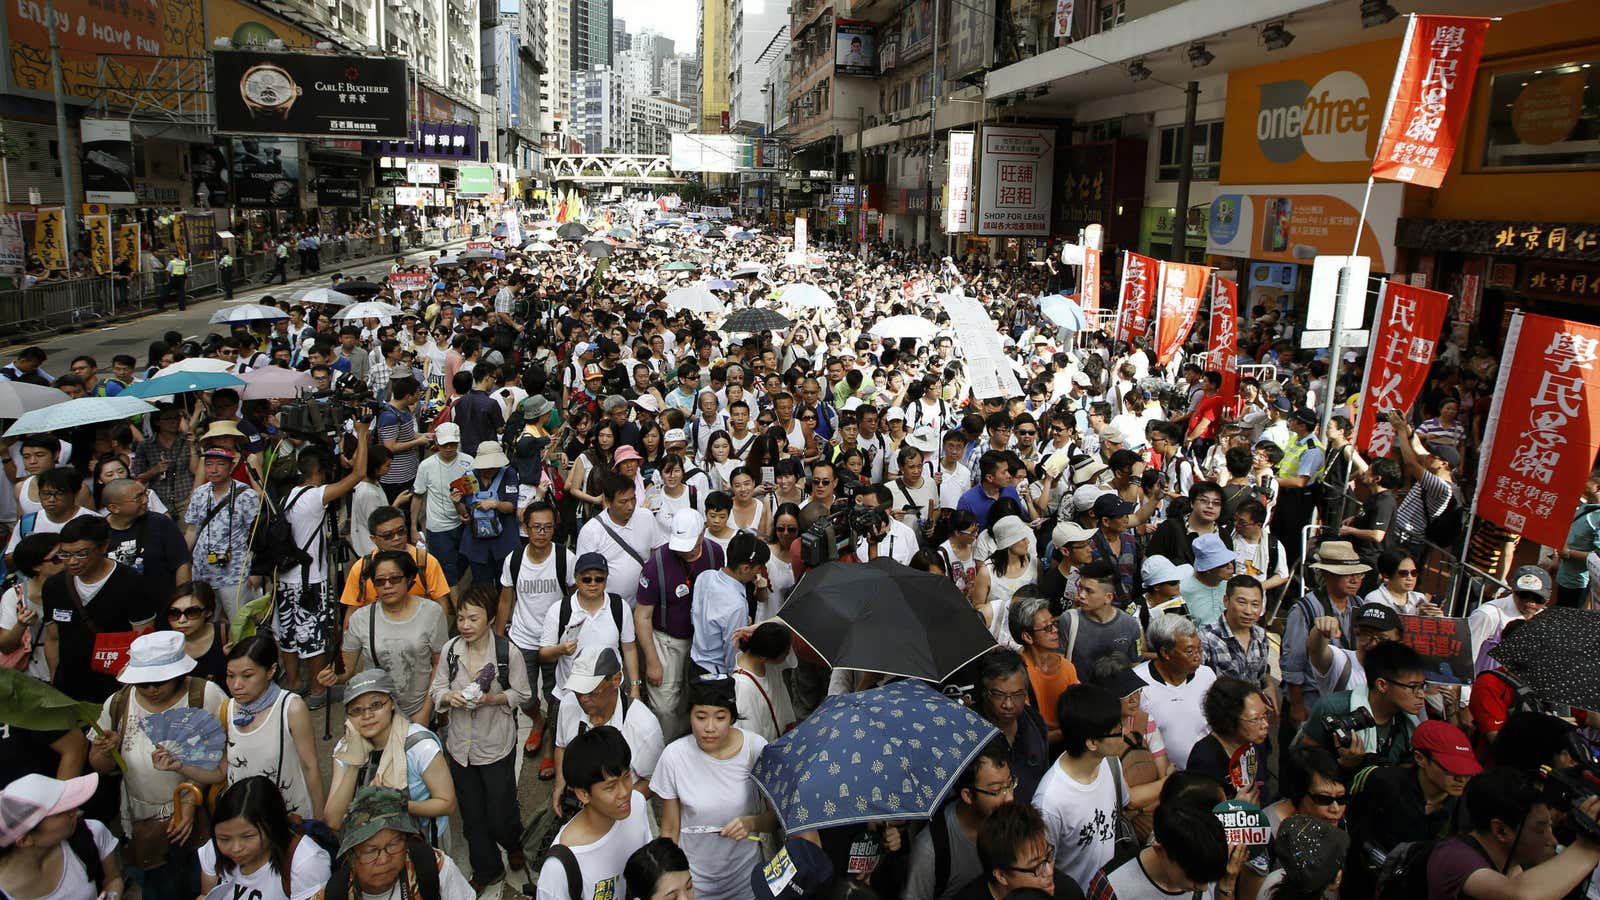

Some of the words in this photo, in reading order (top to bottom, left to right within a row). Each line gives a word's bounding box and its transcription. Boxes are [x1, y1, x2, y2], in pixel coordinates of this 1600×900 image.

[314, 82, 337, 91] CARL
[338, 82, 345, 92] F.
[346, 83, 390, 94] BUCHERER
[1405, 25, 1466, 144] 學民思潮
[1257, 90, 1371, 140] one2free
[1000, 186, 1032, 205] 招租
[984, 212, 1004, 220] SHOP
[1007, 213, 1022, 221] FOR
[1024, 213, 1046, 221] LEASE
[1495, 226, 1597, 252] 北京同仁
[1509, 331, 1600, 485] 學民思潮
[1497, 475, 1559, 507] 堅守街頭
[519, 578, 557, 594] LONDON
